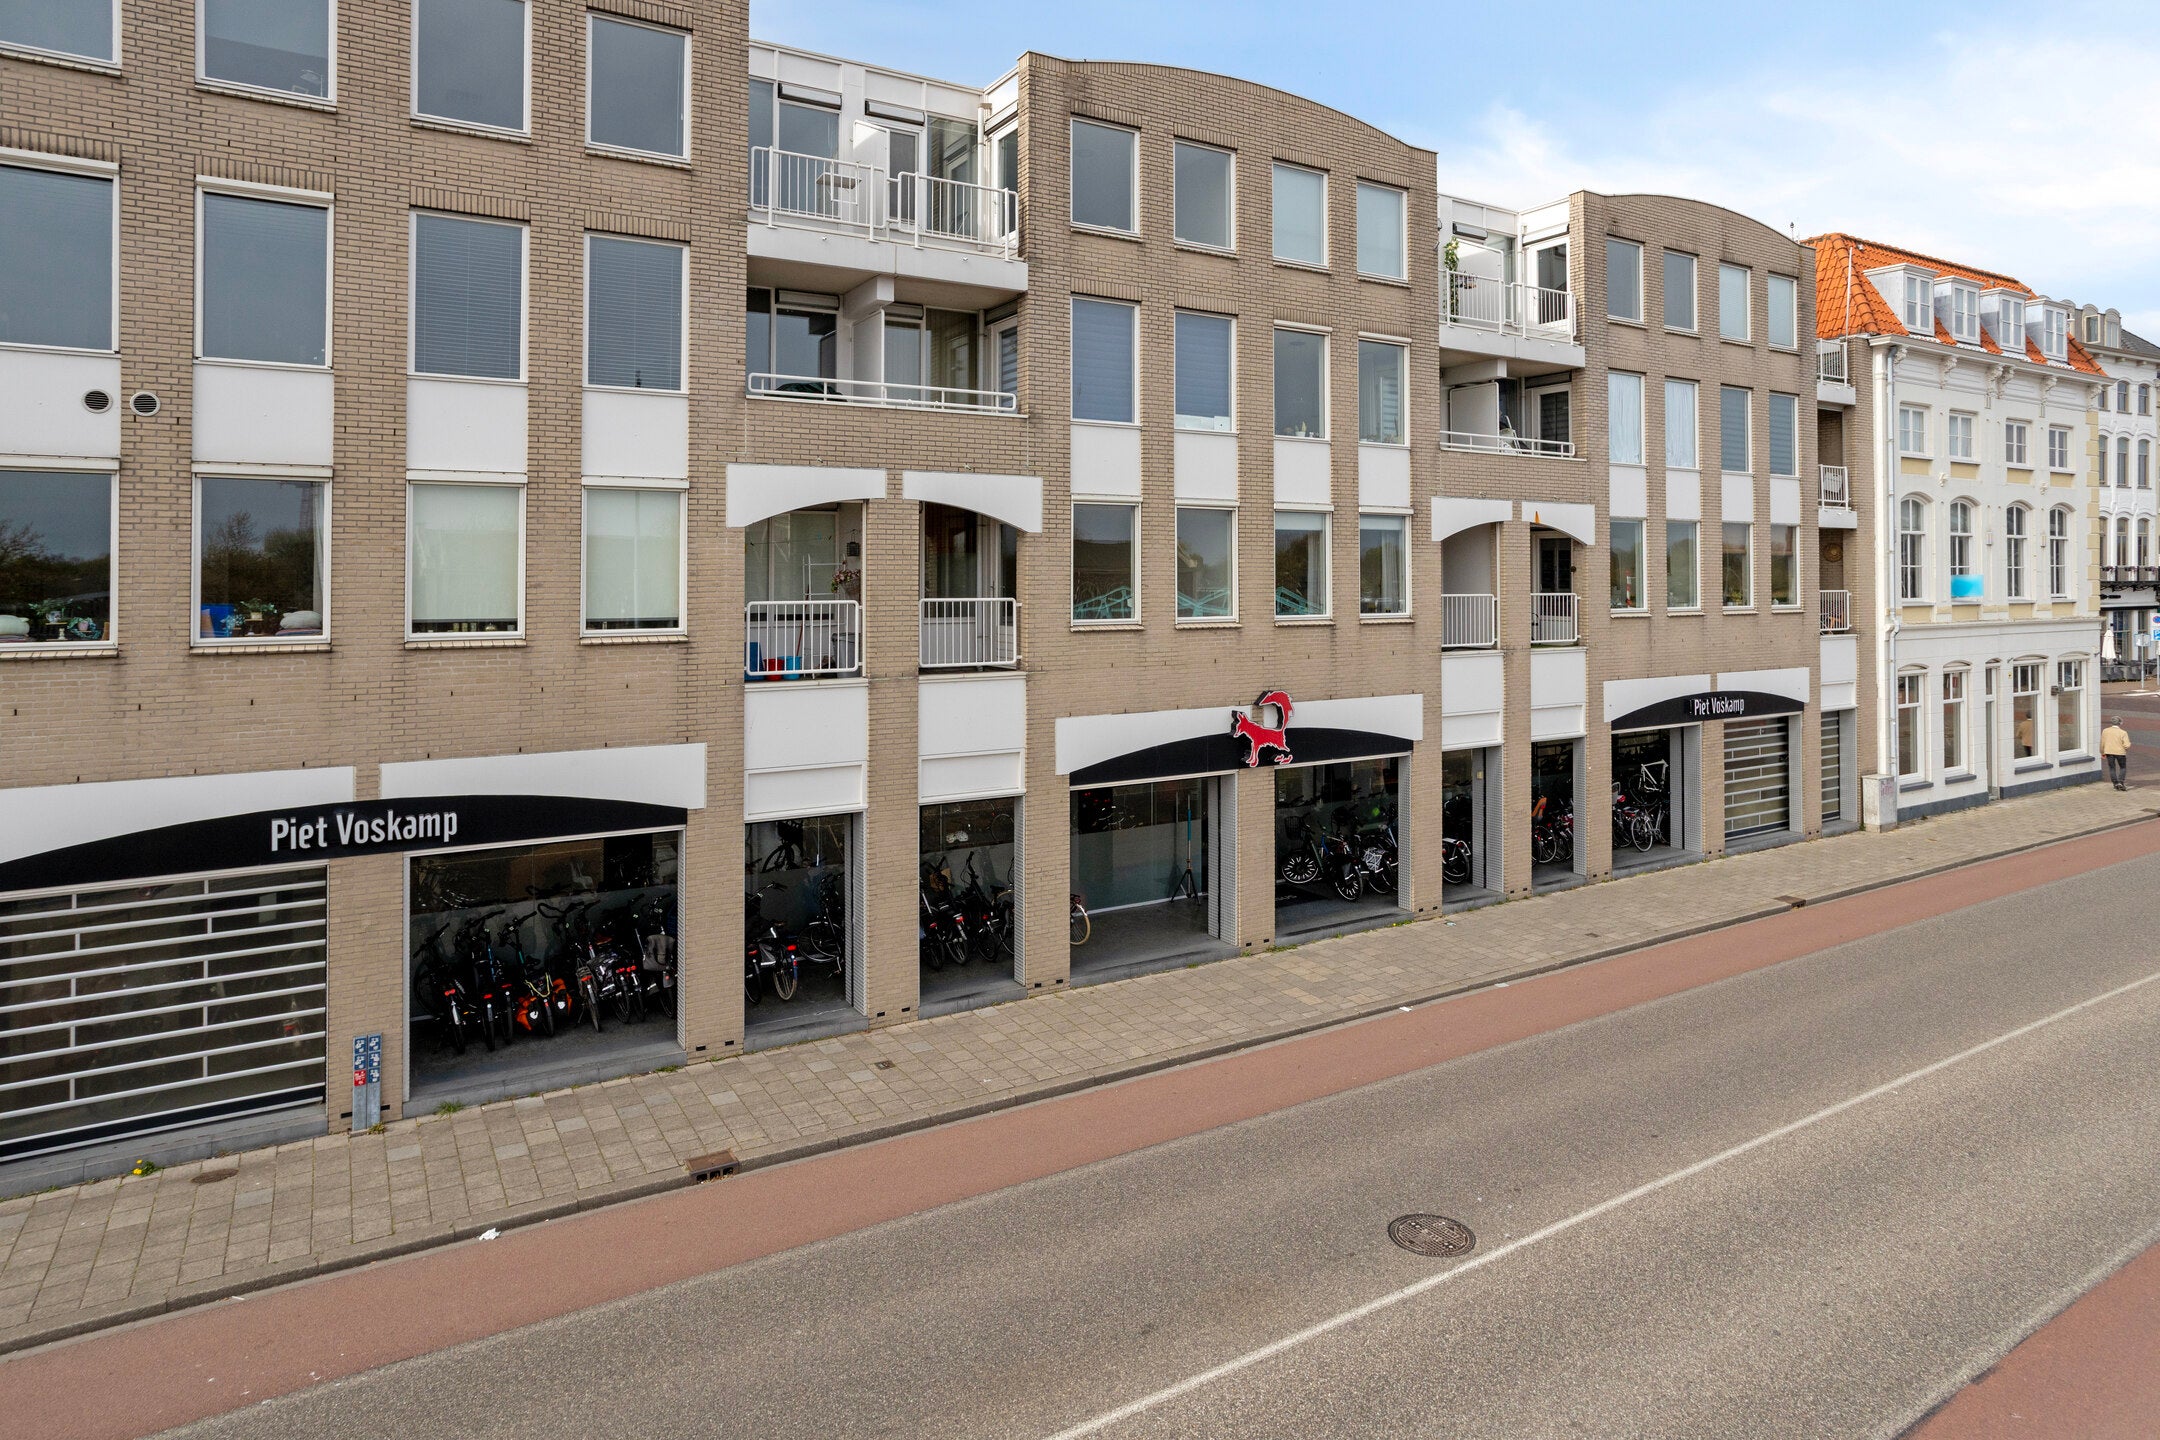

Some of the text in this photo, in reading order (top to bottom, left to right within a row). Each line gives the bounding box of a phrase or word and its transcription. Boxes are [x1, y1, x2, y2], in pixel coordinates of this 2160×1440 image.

[1694, 697, 1745, 716] Piet Voskamp
[271, 809, 458, 852] Piet Voskamp
